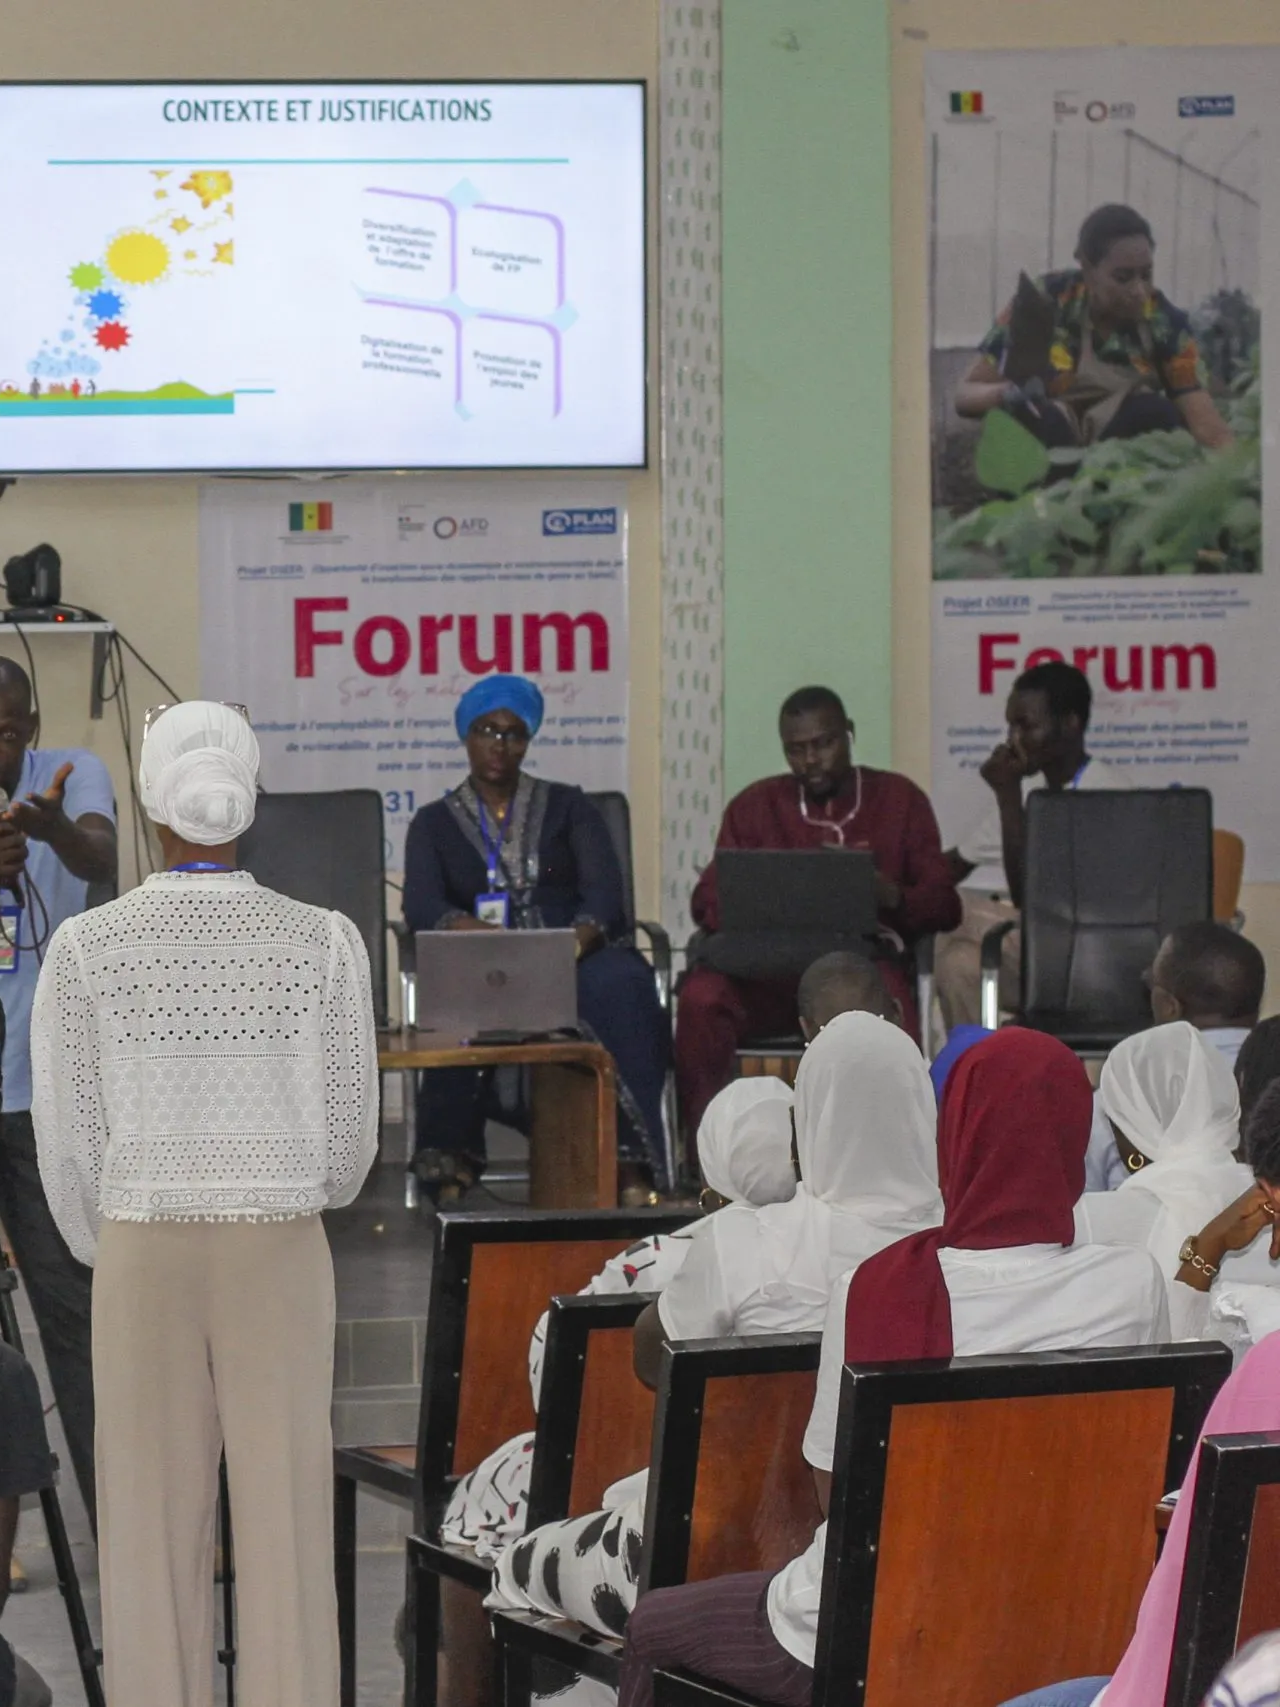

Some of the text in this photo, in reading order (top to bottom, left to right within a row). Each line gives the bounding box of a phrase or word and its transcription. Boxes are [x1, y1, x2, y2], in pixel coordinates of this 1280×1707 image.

[163, 99, 493, 122] CONTEXTE ET JUSTIFICATIONS
[460, 518, 489, 531] AFD
[572, 510, 615, 525] PLAN
[294, 597, 610, 678] Forum
[386, 789, 414, 813] 31
